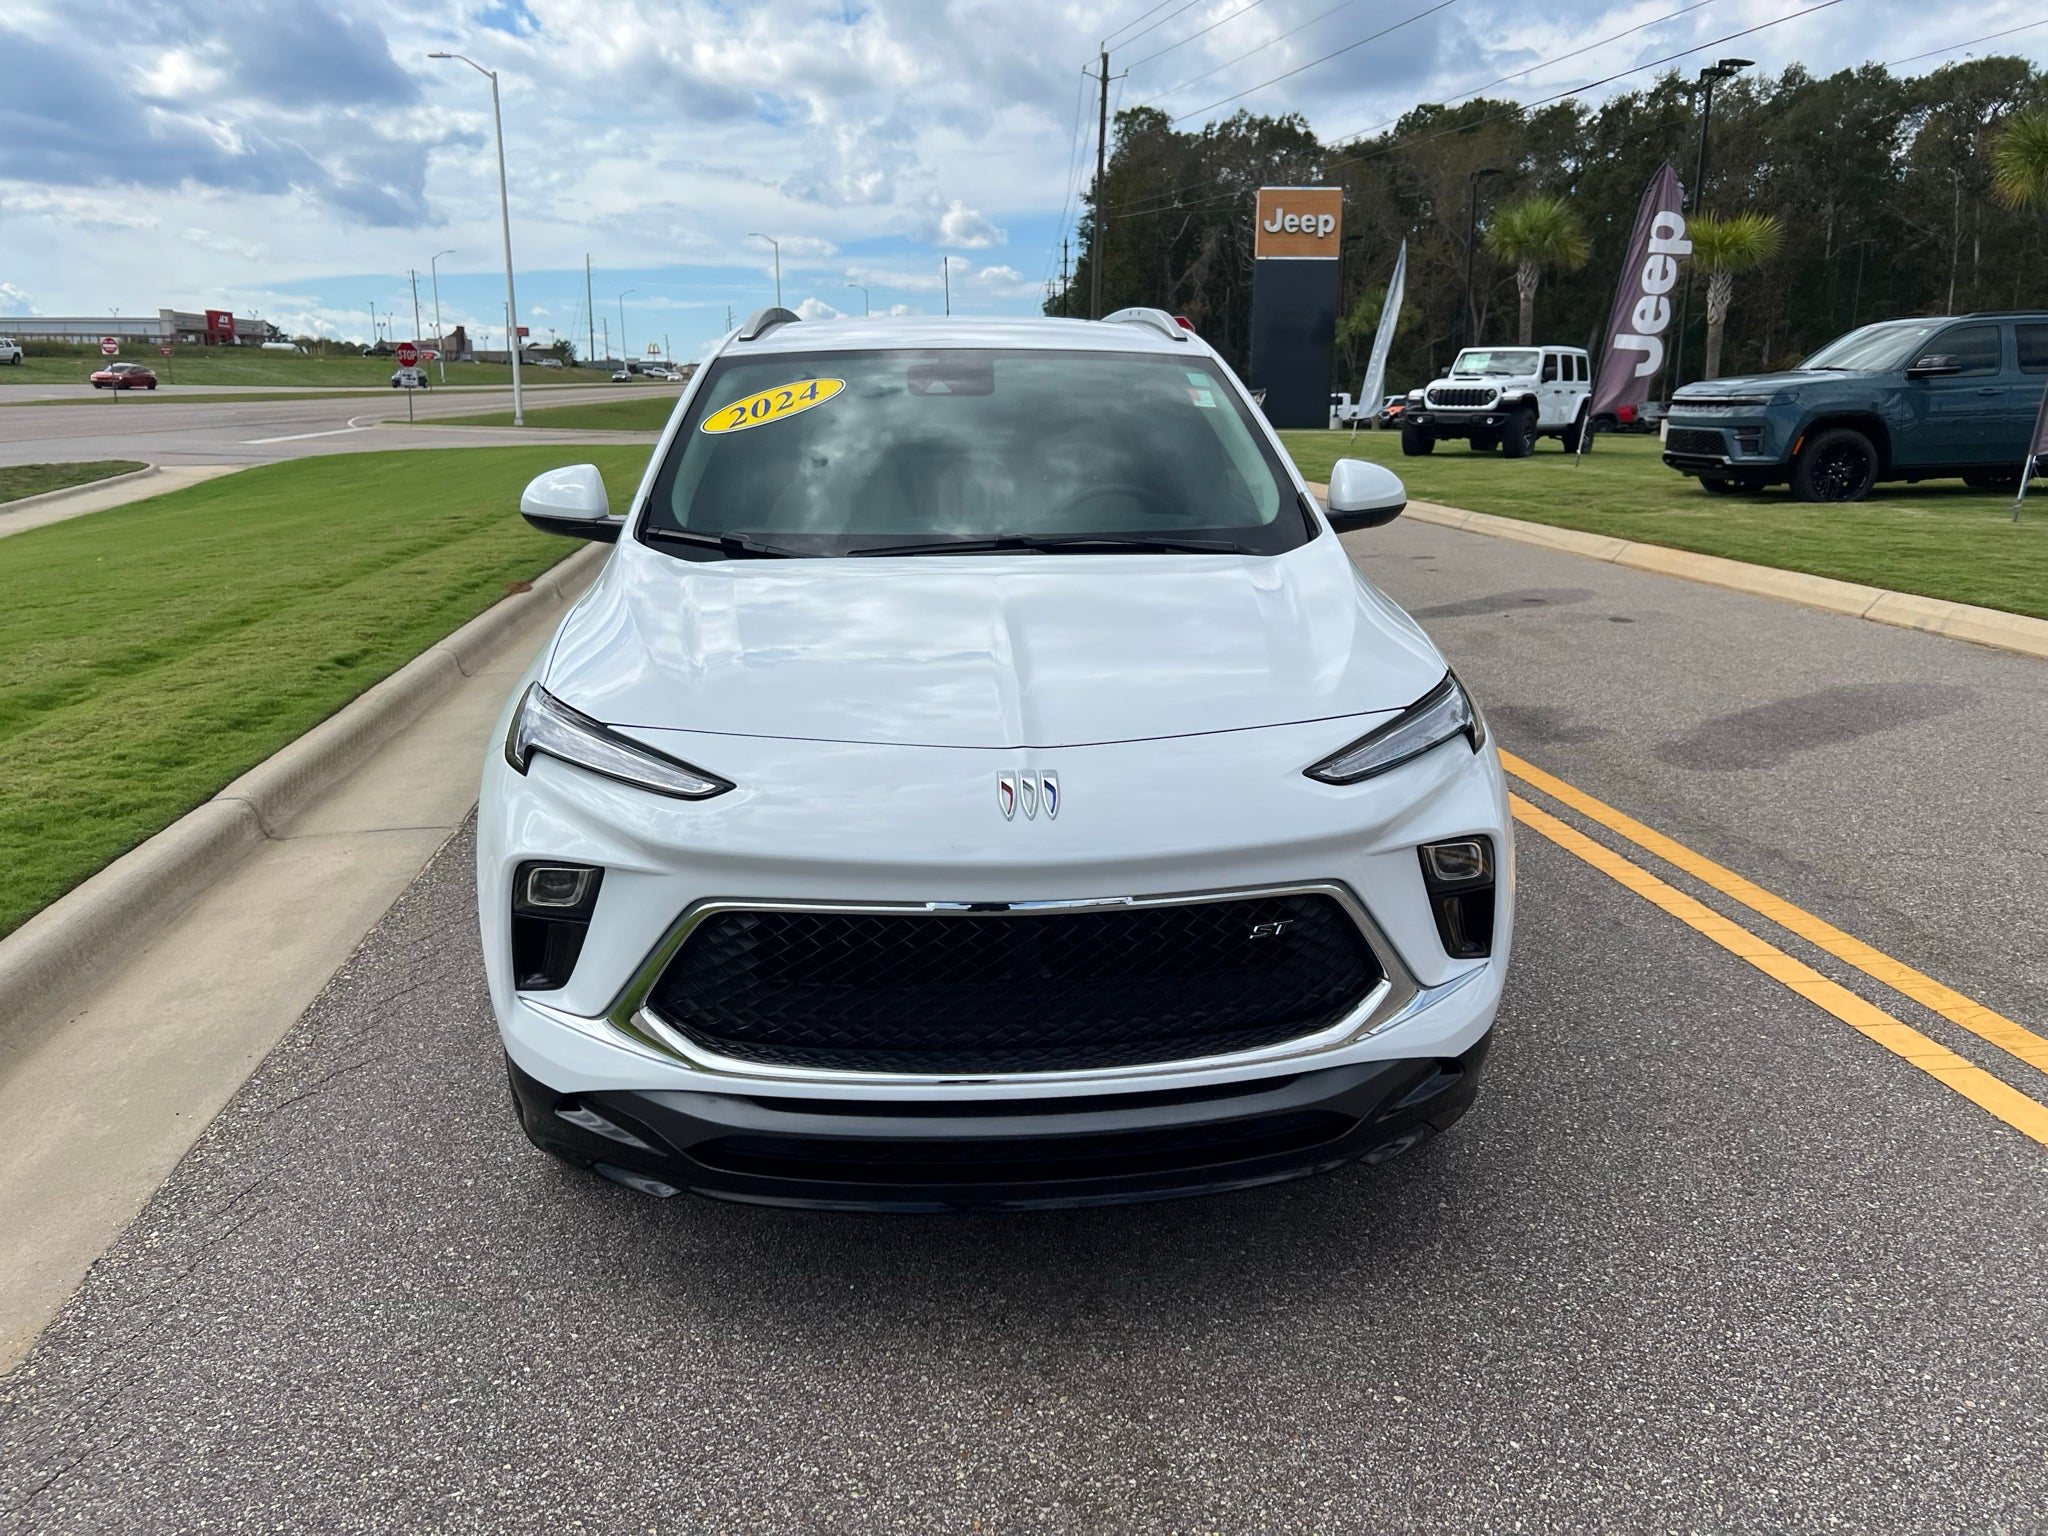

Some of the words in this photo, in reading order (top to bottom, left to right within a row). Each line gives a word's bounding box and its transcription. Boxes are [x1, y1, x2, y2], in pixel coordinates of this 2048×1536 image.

[1263, 208, 1336, 238] Jeep
[1612, 210, 1693, 378] Jeep
[397, 349, 417, 361] STOP
[728, 381, 820, 429] 2024
[1249, 919, 1294, 940] ST
